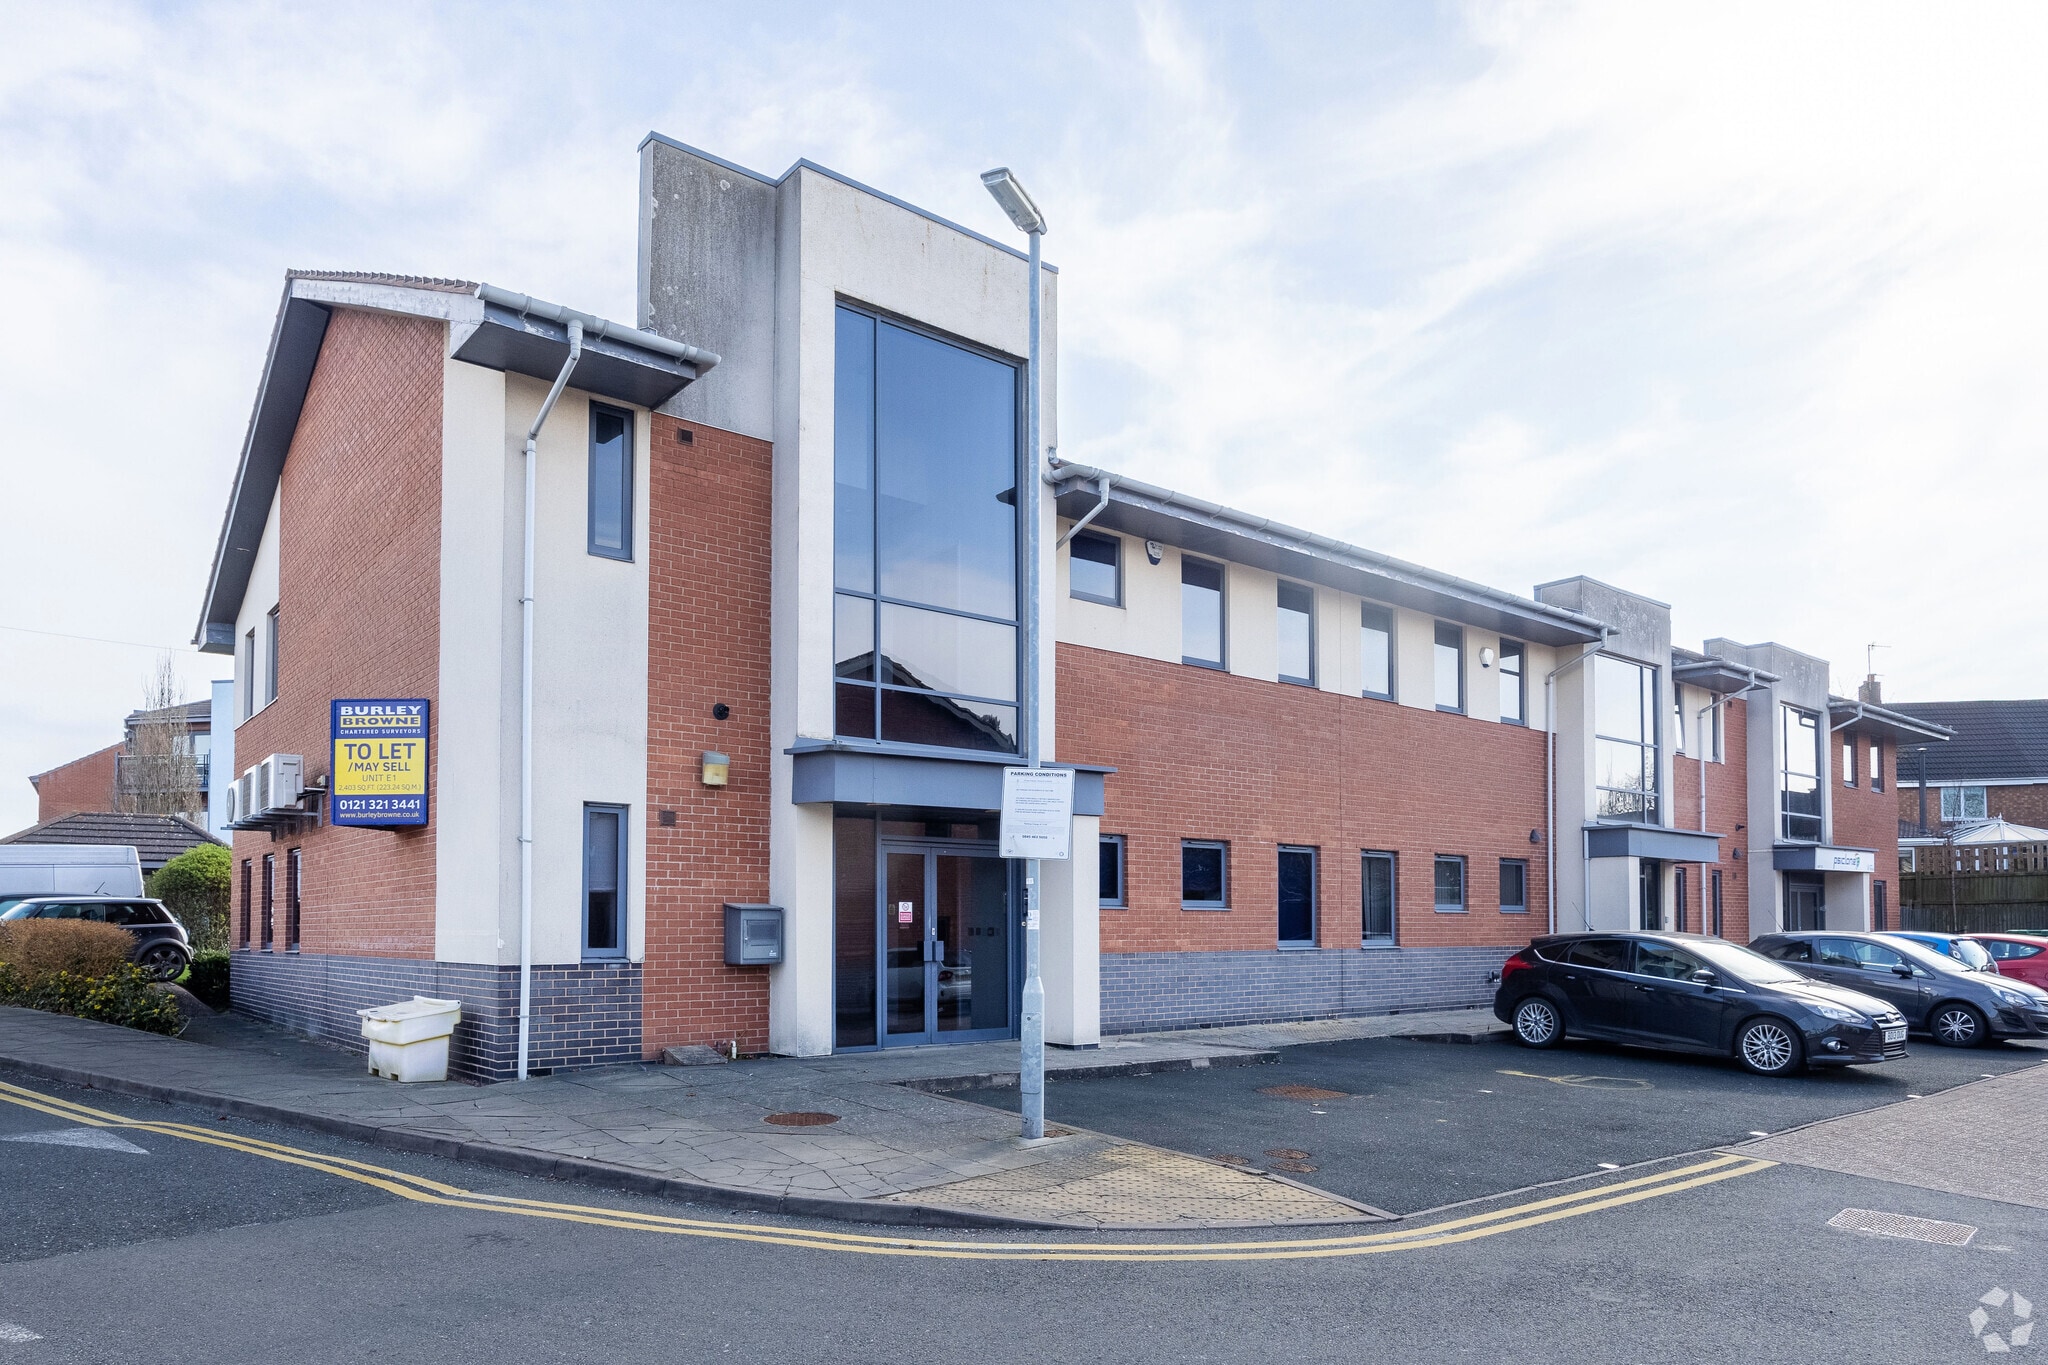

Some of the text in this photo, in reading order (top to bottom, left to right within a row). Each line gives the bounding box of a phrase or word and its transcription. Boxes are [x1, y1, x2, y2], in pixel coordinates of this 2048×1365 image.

[340, 705, 422, 716] BURLEY
[342, 717, 420, 725] BROWNE
[343, 743, 417, 760] TO LET
[348, 761, 411, 772] /MAY SELL
[362, 774, 384, 782] UNIT
[339, 799, 420, 810] 0121 321 3441
[339, 811, 420, 819] www.burleybrowne.co.uk
